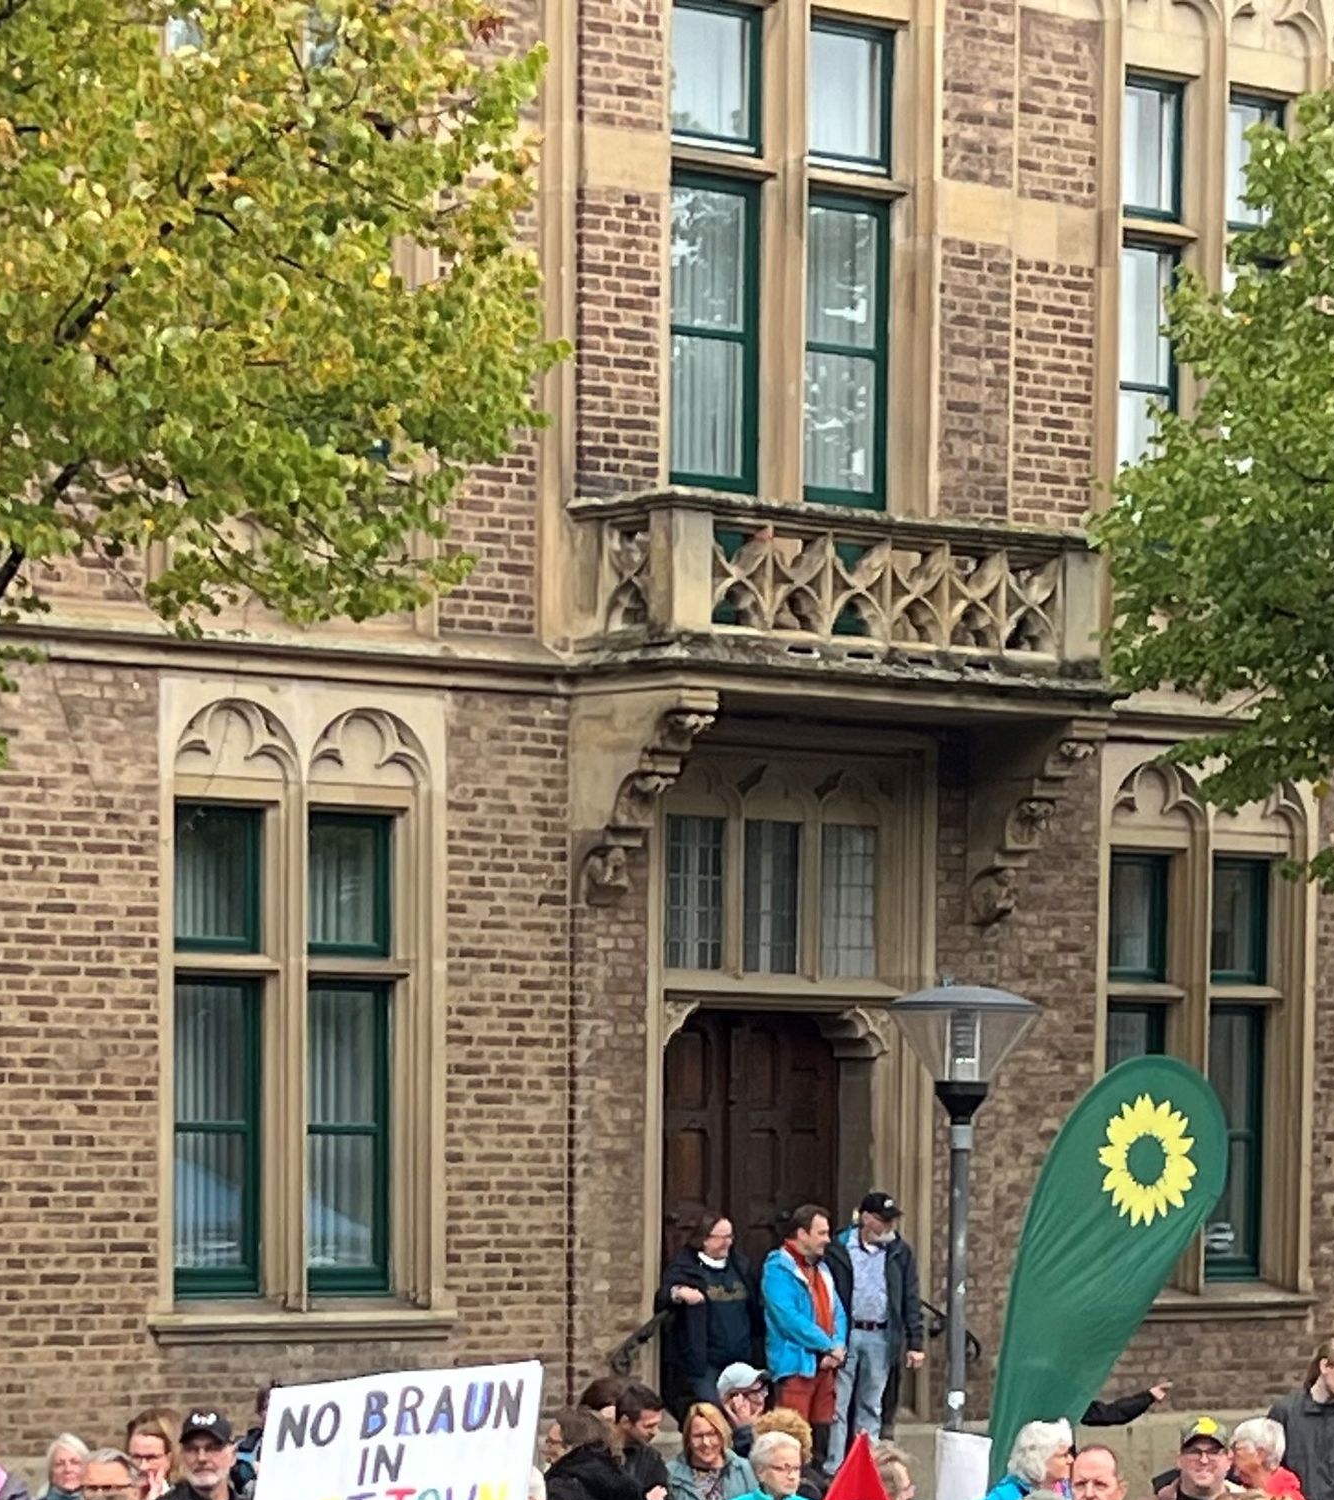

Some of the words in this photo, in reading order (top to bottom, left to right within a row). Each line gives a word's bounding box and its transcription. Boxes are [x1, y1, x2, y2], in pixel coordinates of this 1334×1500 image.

[276, 1401, 341, 1452] NO
[359, 1378, 525, 1440] BRAUN
[357, 1444, 405, 1486] IN
